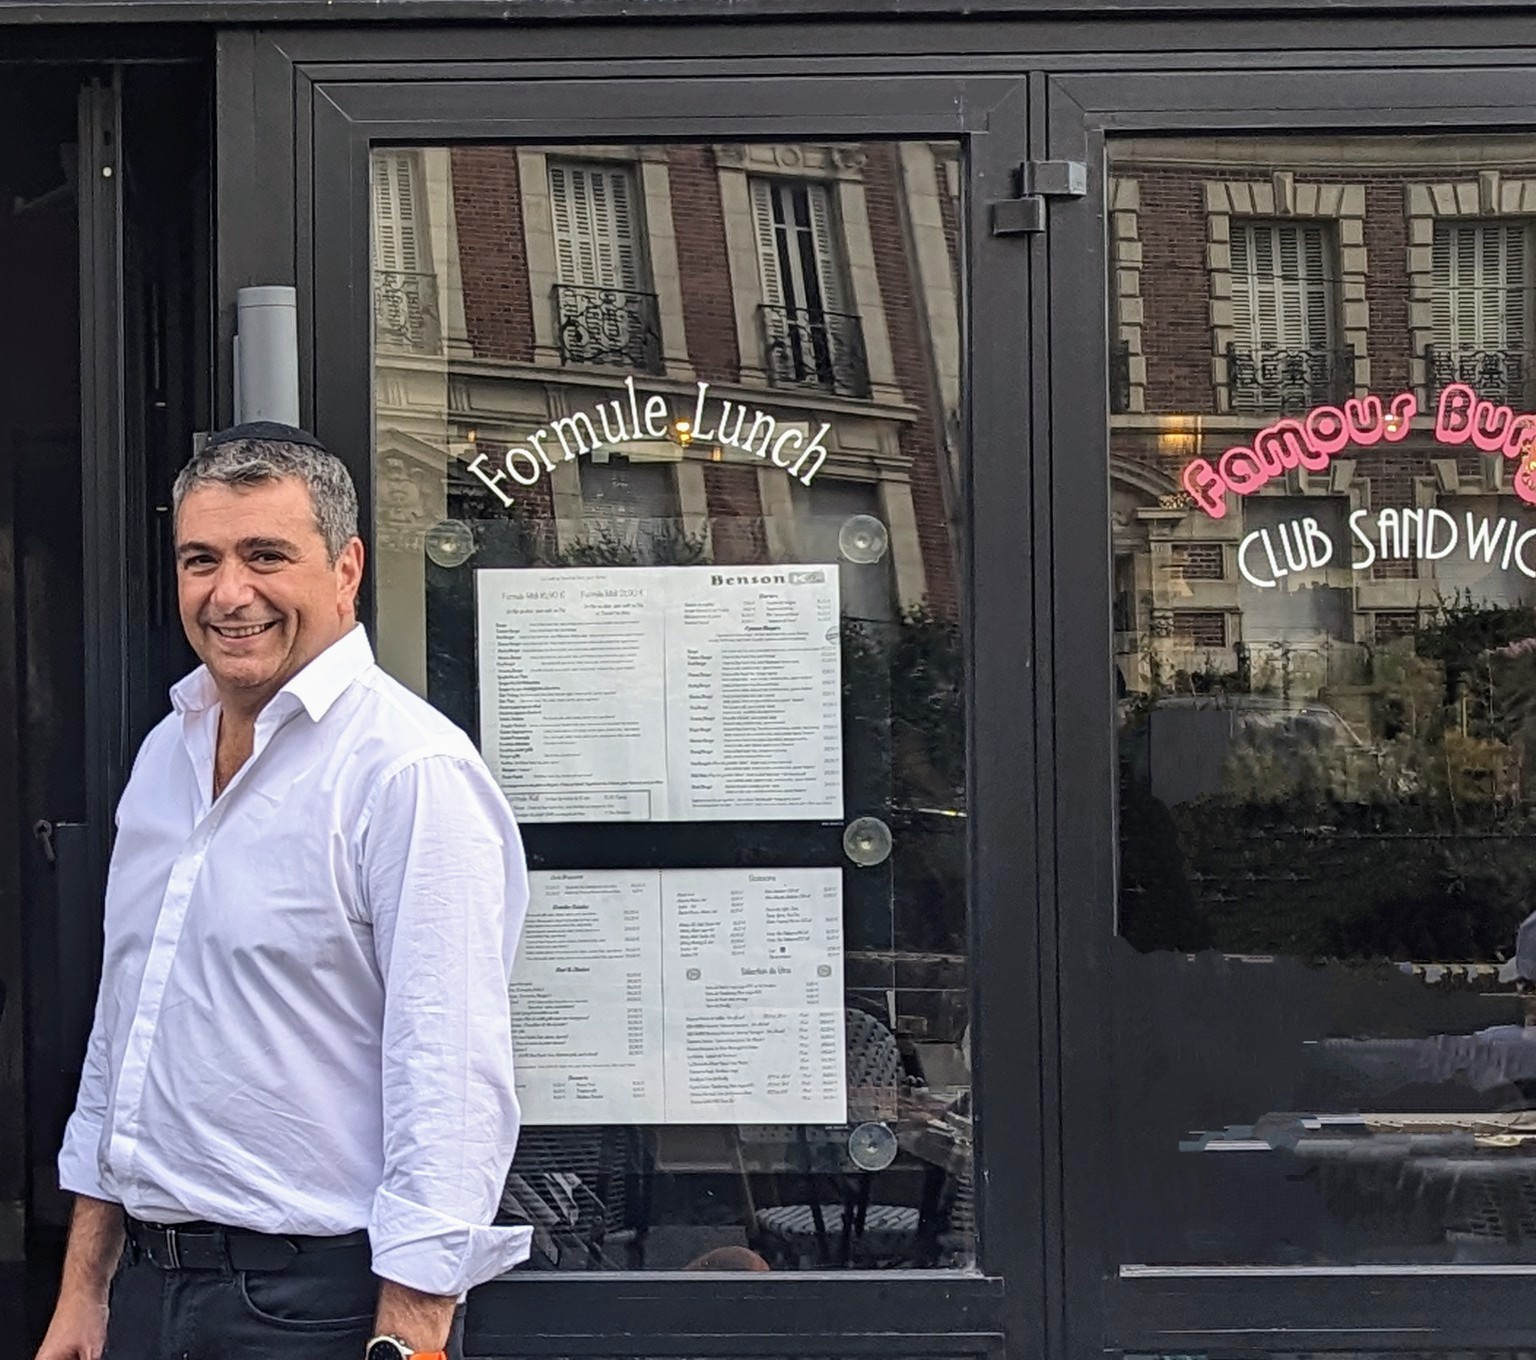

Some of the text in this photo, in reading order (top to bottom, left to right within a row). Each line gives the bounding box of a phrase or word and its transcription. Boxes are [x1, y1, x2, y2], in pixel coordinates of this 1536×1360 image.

[467, 376, 833, 508] Formule Lunch
[1182, 392, 1418, 519] Famous
[711, 574, 786, 586] Benson
[1238, 516, 1333, 588] CLUB
